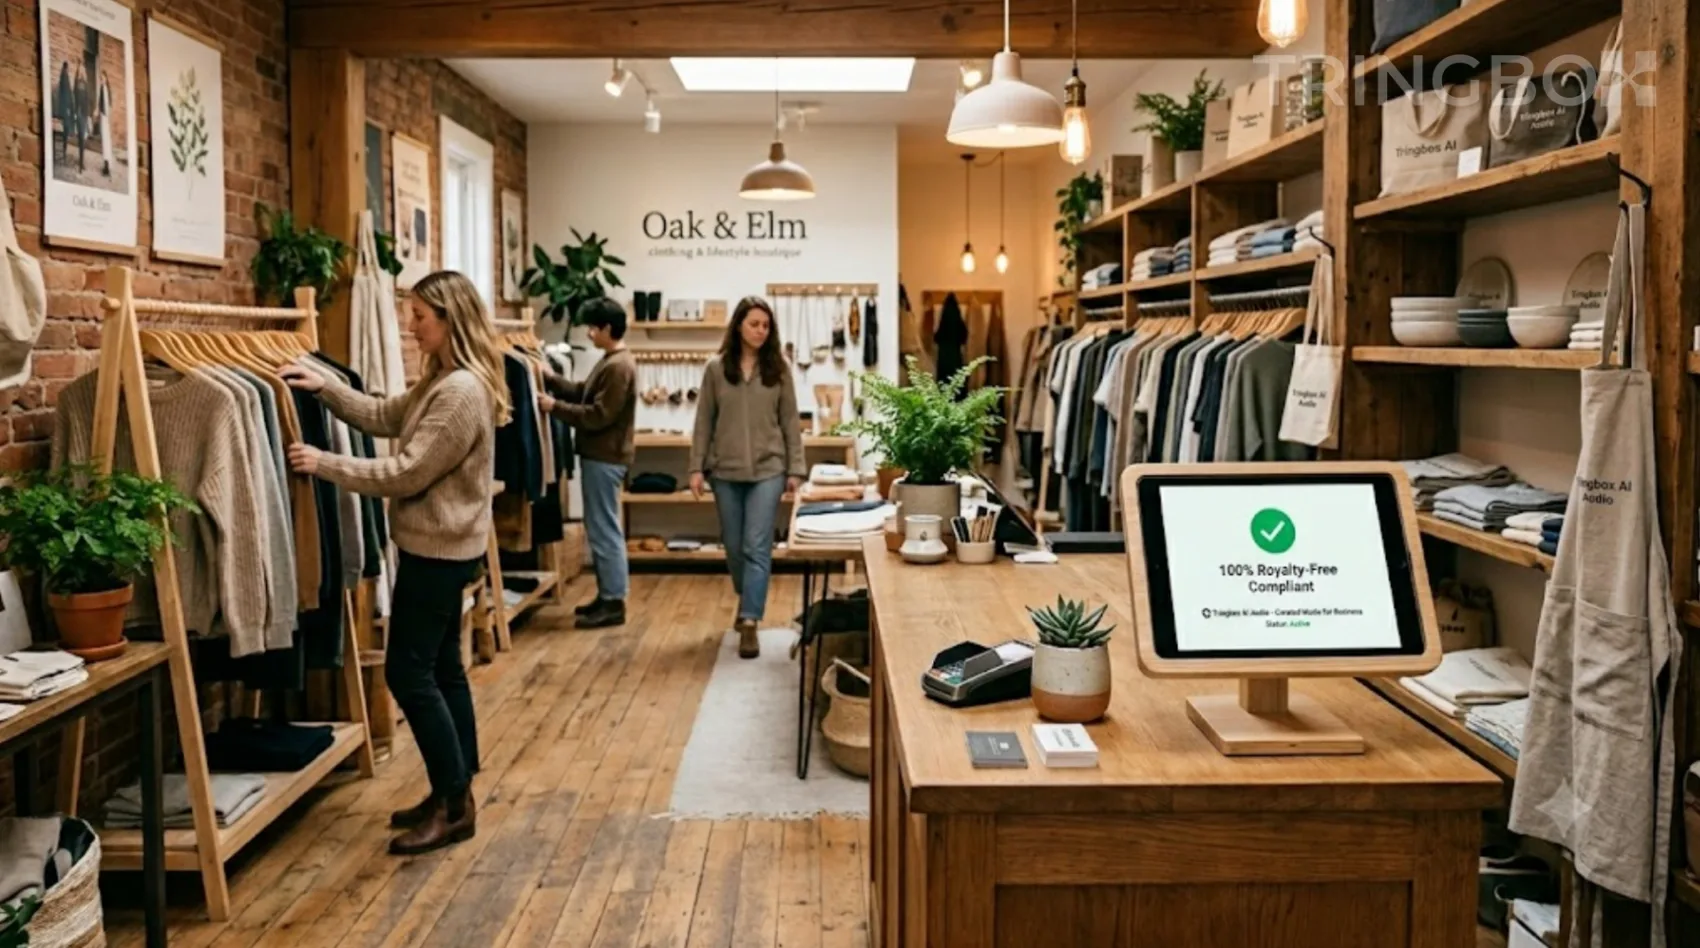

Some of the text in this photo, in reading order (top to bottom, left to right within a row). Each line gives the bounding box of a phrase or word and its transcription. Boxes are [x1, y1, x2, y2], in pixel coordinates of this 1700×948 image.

[1444, 139, 1457, 151] AI
[642, 210, 808, 240] Oak & Elm
[1618, 480, 1632, 492] AI
[1219, 562, 1338, 579] 100% Royalty-Free
[1248, 579, 1315, 596] Compliant
